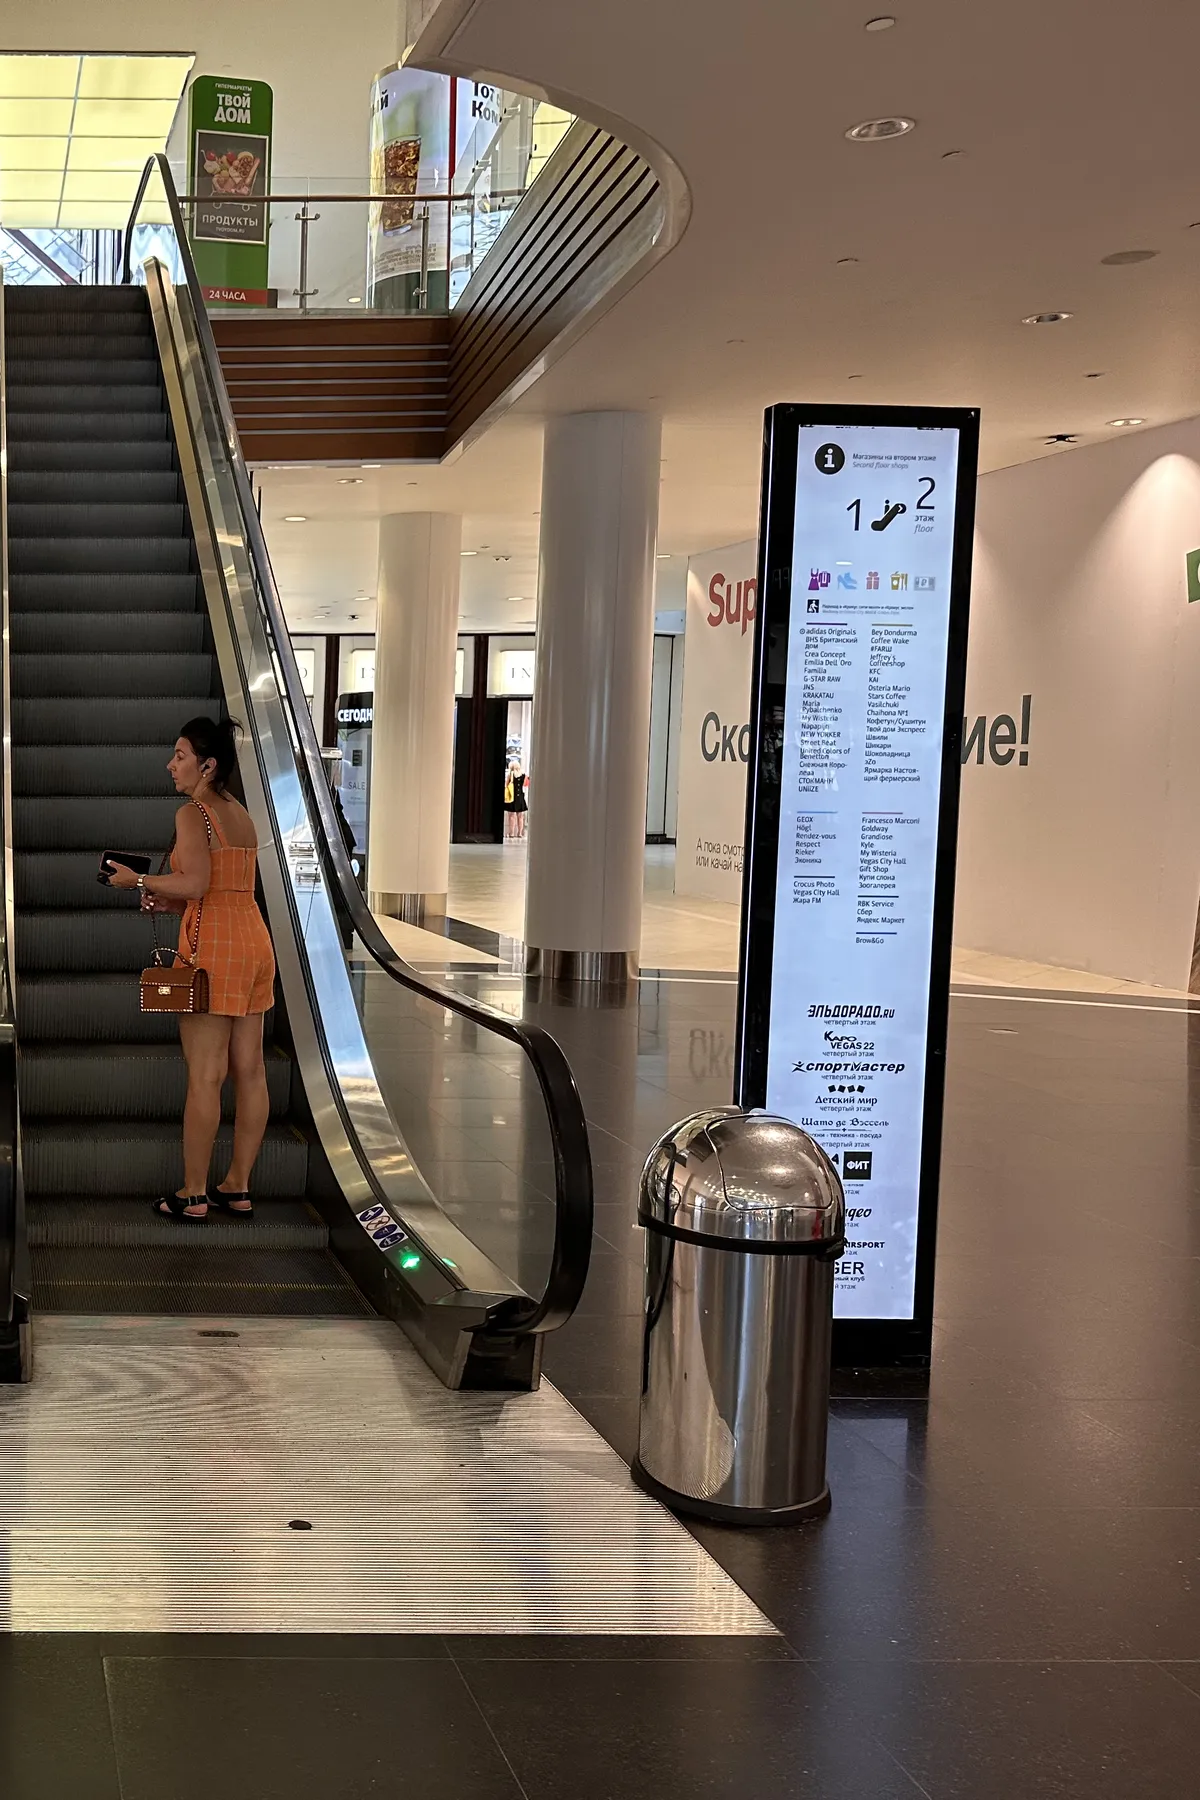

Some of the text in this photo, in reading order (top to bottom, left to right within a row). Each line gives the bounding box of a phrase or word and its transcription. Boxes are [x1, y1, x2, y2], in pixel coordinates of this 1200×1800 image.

[217, 93, 250, 108] ТВОЙ
[214, 106, 251, 124] ДОМ
[202, 215, 258, 226] ПРОДУКТЫ
[209, 290, 246, 300] 24 ЧАСА
[916, 476, 936, 510] 2
[846, 498, 860, 531] 1
[914, 524, 933, 534] floor
[707, 573, 757, 636] Sup
[338, 708, 373, 722] СЕГОДН
[701, 712, 750, 762] Ско
[348, 781, 366, 790] SALE
[697, 838, 745, 860] А пока смотр
[696, 856, 732, 871] или качай
[807, 1005, 895, 1018] ЭЛЬДОРАДО.RU
[815, 1096, 878, 1106] Детский мир
[801, 1118, 833, 1126] Шато
[846, 1160, 869, 1170] ФИТ
